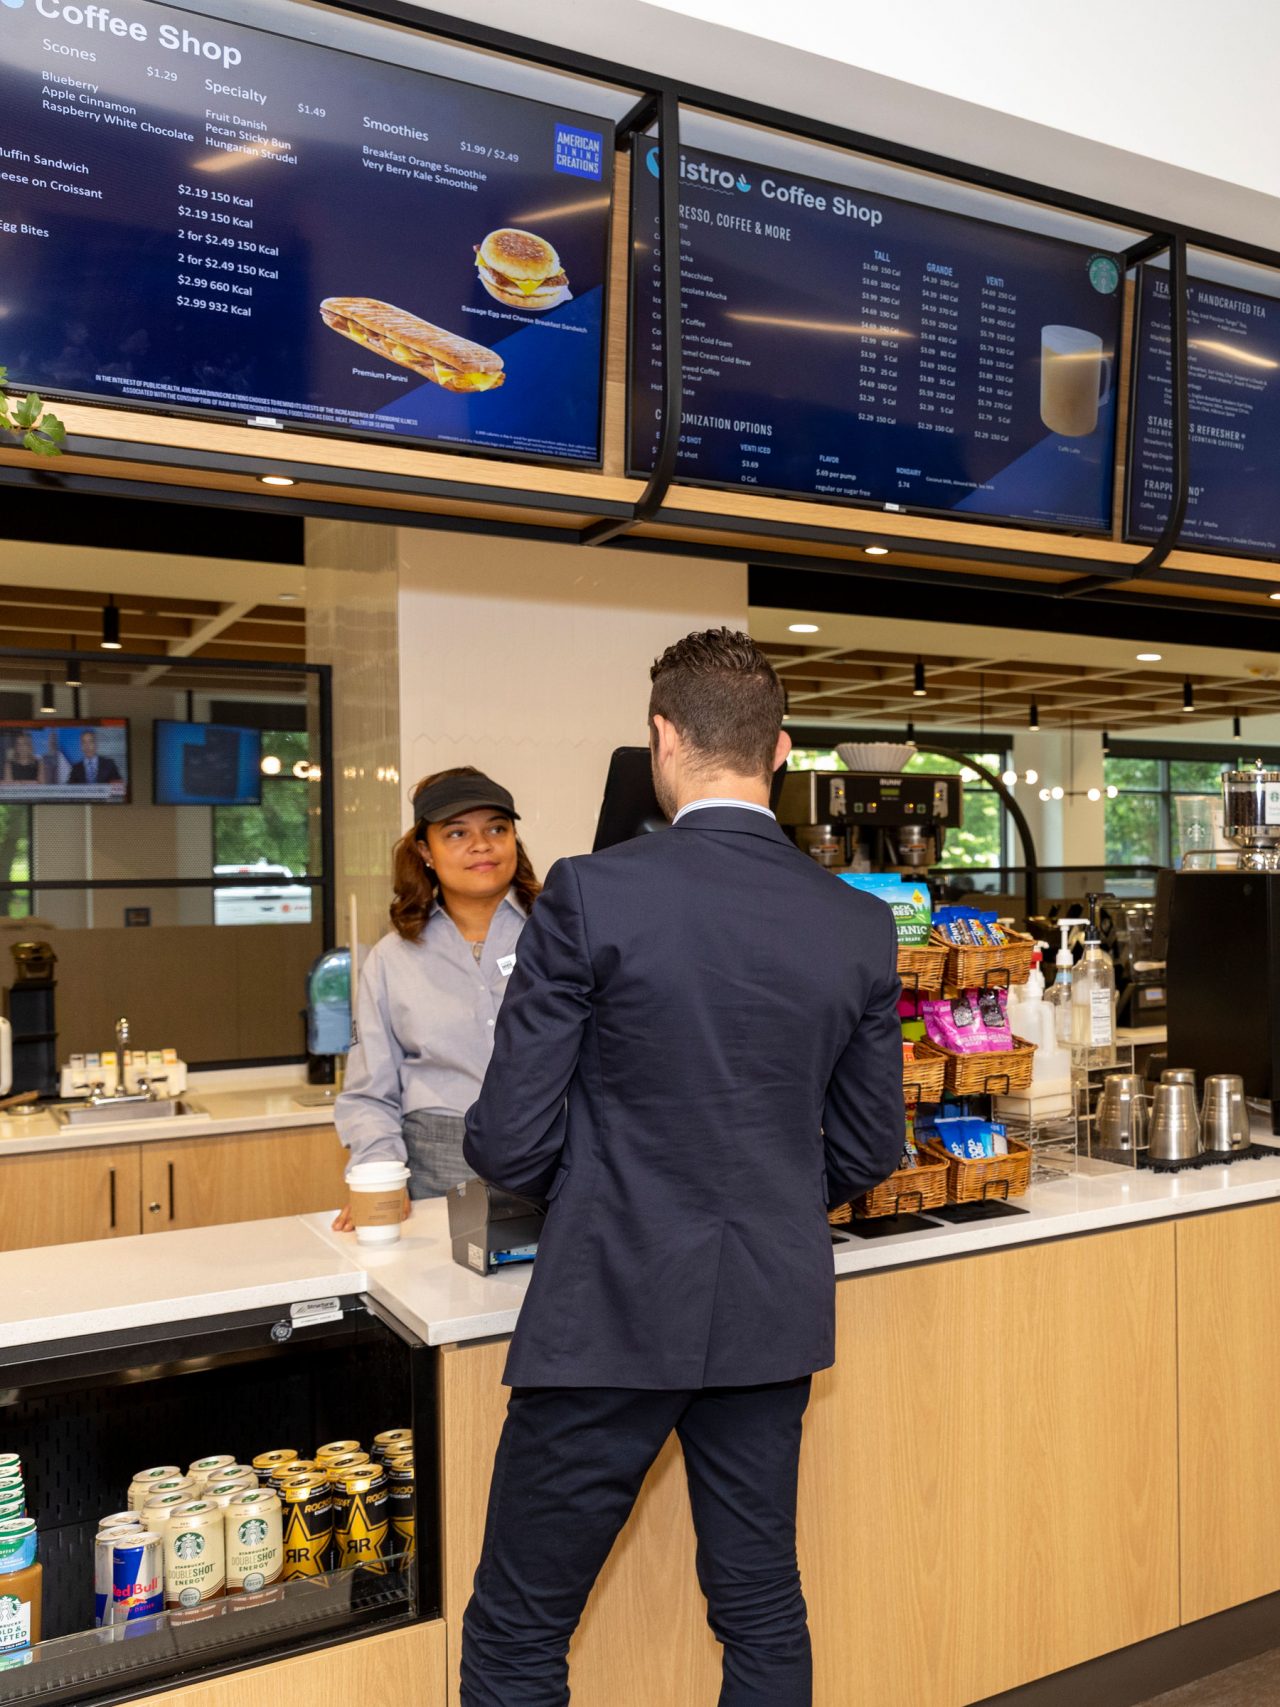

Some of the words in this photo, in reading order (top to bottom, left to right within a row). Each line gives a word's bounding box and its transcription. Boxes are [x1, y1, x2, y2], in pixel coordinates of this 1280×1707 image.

[35, 0, 148, 42] Coffee
[158, 24, 243, 69] Shop
[42, 38, 97, 63] Scones
[41, 71, 99, 94] Blueberry
[146, 66, 178, 82] $1.29
[41, 85, 76, 103] Apple
[79, 94, 137, 115] Cinnamon
[204, 79, 267, 106] Specialty
[297, 102, 326, 118] $1.49
[42, 100, 101, 122] Raspberry
[103, 114, 138, 130] White
[140, 122, 194, 143] Chocolate
[205, 109, 231, 125] Fruit
[232, 115, 267, 131] Danish
[363, 116, 429, 142] Smoothies
[205, 123, 237, 138] Pecan
[239, 130, 270, 147] Sticky
[271, 138, 292, 150] Bun
[557, 131, 600, 152] AMERICAN
[205, 136, 260, 157] Hungarian
[261, 148, 298, 165] Strudel
[460, 141, 486, 156] $1.99
[493, 148, 520, 163] $2.49
[557, 144, 599, 162] DINING
[0, 147, 31, 163] uffin
[34, 154, 89, 175] Sandwich
[362, 145, 407, 163] Breakfast
[408, 155, 442, 172] Orange
[443, 163, 487, 181] Smoothie
[556, 155, 599, 174] CREATIONS
[362, 158, 384, 173] Very
[386, 162, 412, 179] Berry
[413, 169, 433, 182] Kale
[434, 174, 478, 192] Smoothie
[1, 172, 28, 185] eese
[32, 178, 47, 189] on
[50, 180, 103, 199] Croissant
[680, 155, 735, 189] istro
[761, 179, 826, 211] Coffee
[832, 196, 883, 227] Shop
[178, 183, 208, 199] $2.19
[211, 191, 231, 203] 150
[232, 195, 254, 208] Kcal
[178, 205, 208, 220] $2.19
[211, 212, 231, 225] 150
[232, 216, 253, 229] Kcal
[679, 204, 713, 226] RESSO,
[717, 213, 752, 233] COFFEE
[755, 221, 762, 235] &
[765, 224, 791, 242] MORE
[20, 223, 49, 238] Bites
[178, 229, 185, 239] 2
[187, 230, 203, 242] for
[204, 233, 235, 248] $2.49
[237, 240, 257, 253] 150
[258, 244, 279, 257] Kcal
[874, 250, 891, 263] TALL
[178, 253, 185, 263] 2
[187, 254, 203, 266] for
[204, 257, 235, 272] $2.49
[237, 264, 257, 276] 150
[258, 268, 279, 280] Kcal
[926, 262, 953, 277] GRANDE
[177, 274, 208, 289] $2.99
[209, 280, 230, 293] 660
[232, 284, 253, 297] Kcal
[986, 275, 1004, 288] VENTI
[681, 287, 705, 298] ocolate
[706, 290, 727, 301] Mocha
[176, 295, 207, 309] $2.99
[208, 301, 229, 314] 932
[230, 304, 251, 317] Kcal
[1198, 292, 1251, 314] HANDCRAFTED
[1252, 305, 1266, 318] TEA
[461, 305, 487, 317] Sausage
[488, 310, 500, 320] Egg
[500, 312, 511, 321] and
[512, 314, 534, 325] Cheese
[534, 318, 561, 329] Breakfast
[562, 322, 588, 334] Sandwich
[685, 318, 706, 328] Coffee
[686, 334, 699, 344] with
[700, 336, 715, 347] Cold
[716, 338, 732, 348] Foam
[699, 351, 722, 361] Cream
[723, 353, 735, 363] Cold
[735, 356, 751, 366] Brew
[352, 367, 385, 380] Premium
[386, 372, 408, 383] Panini
[700, 366, 720, 377] Coffee
[888, 370, 898, 378] Cal
[733, 421, 772, 436] OPTIONS
[887, 417, 896, 425] Cal
[684, 451, 698, 460] shot
[740, 443, 757, 453] VENTI
[819, 454, 839, 464] FLAVOR
[829, 472, 839, 480] per
[840, 473, 857, 481] pump
[815, 483, 835, 494] regular
[844, 488, 858, 496] sugar
[859, 489, 871, 497] free
[893, 903, 911, 911] ACK
[232, 1548, 277, 1566] DOUBLESHOT
[239, 1561, 269, 1571] ENERGY
[133, 1577, 158, 1593] Bull
[174, 1576, 205, 1586] ENERGY
[0, 1631, 27, 1642] AFTED
